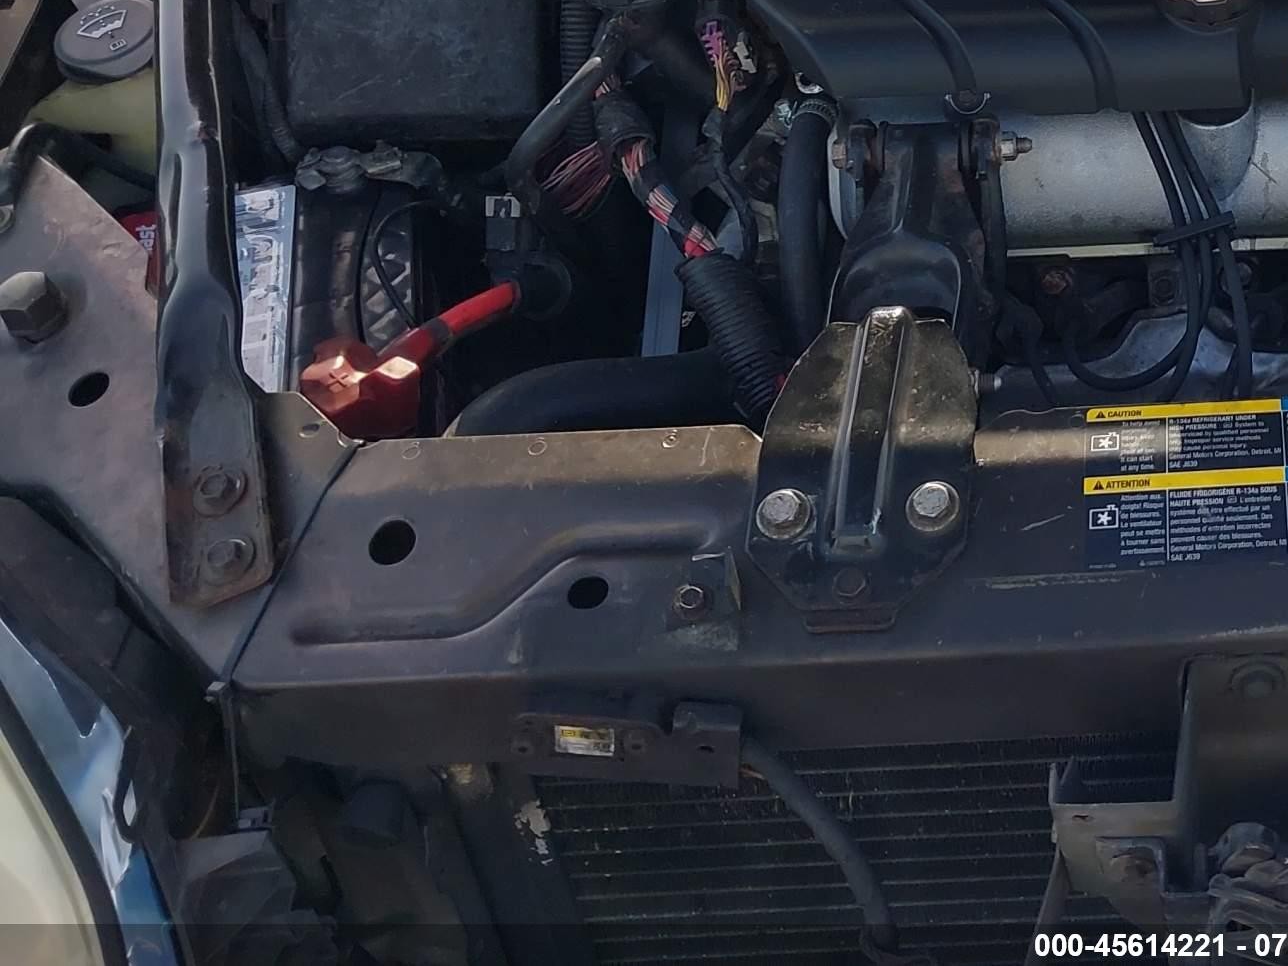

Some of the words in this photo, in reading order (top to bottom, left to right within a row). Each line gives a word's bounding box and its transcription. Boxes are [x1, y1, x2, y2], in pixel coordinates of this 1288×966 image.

[1214, 450, 1250, 458] Corporation,
[1106, 479, 1150, 488] ATTENTION
[1170, 490, 1192, 498] FLUIDE
[1170, 517, 1200, 525] personnel
[1217, 541, 1255, 550] Corporation,
